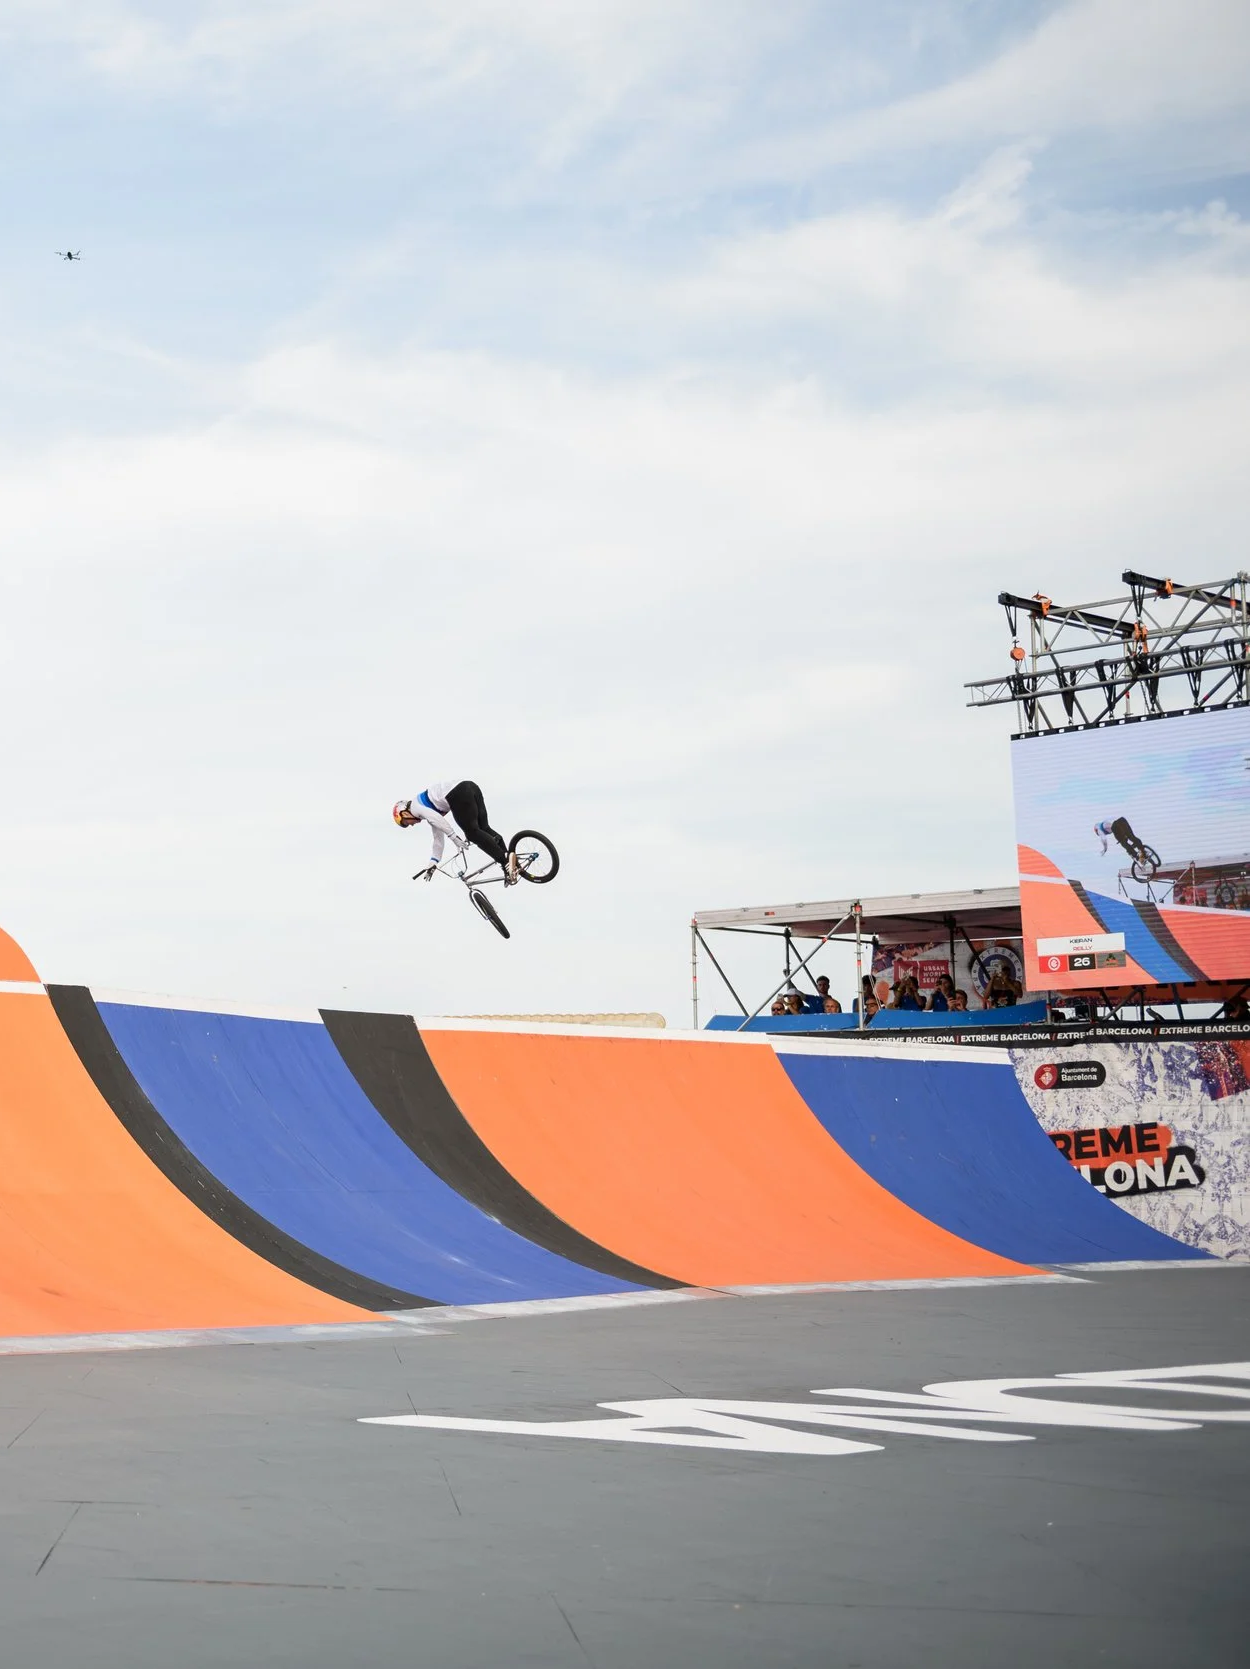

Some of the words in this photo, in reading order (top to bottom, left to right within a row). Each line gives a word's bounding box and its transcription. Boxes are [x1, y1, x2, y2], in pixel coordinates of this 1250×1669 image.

[1074, 958, 1090, 967] 26
[960, 1034, 998, 1043] EXTREME
[1001, 1033, 1050, 1041] BARCELONA
[1096, 1027, 1152, 1036] BARCELONA
[1159, 1025, 1203, 1036] EXTREME
[1061, 1073, 1098, 1082] Barcelona
[1075, 1154, 1200, 1194] LONA
